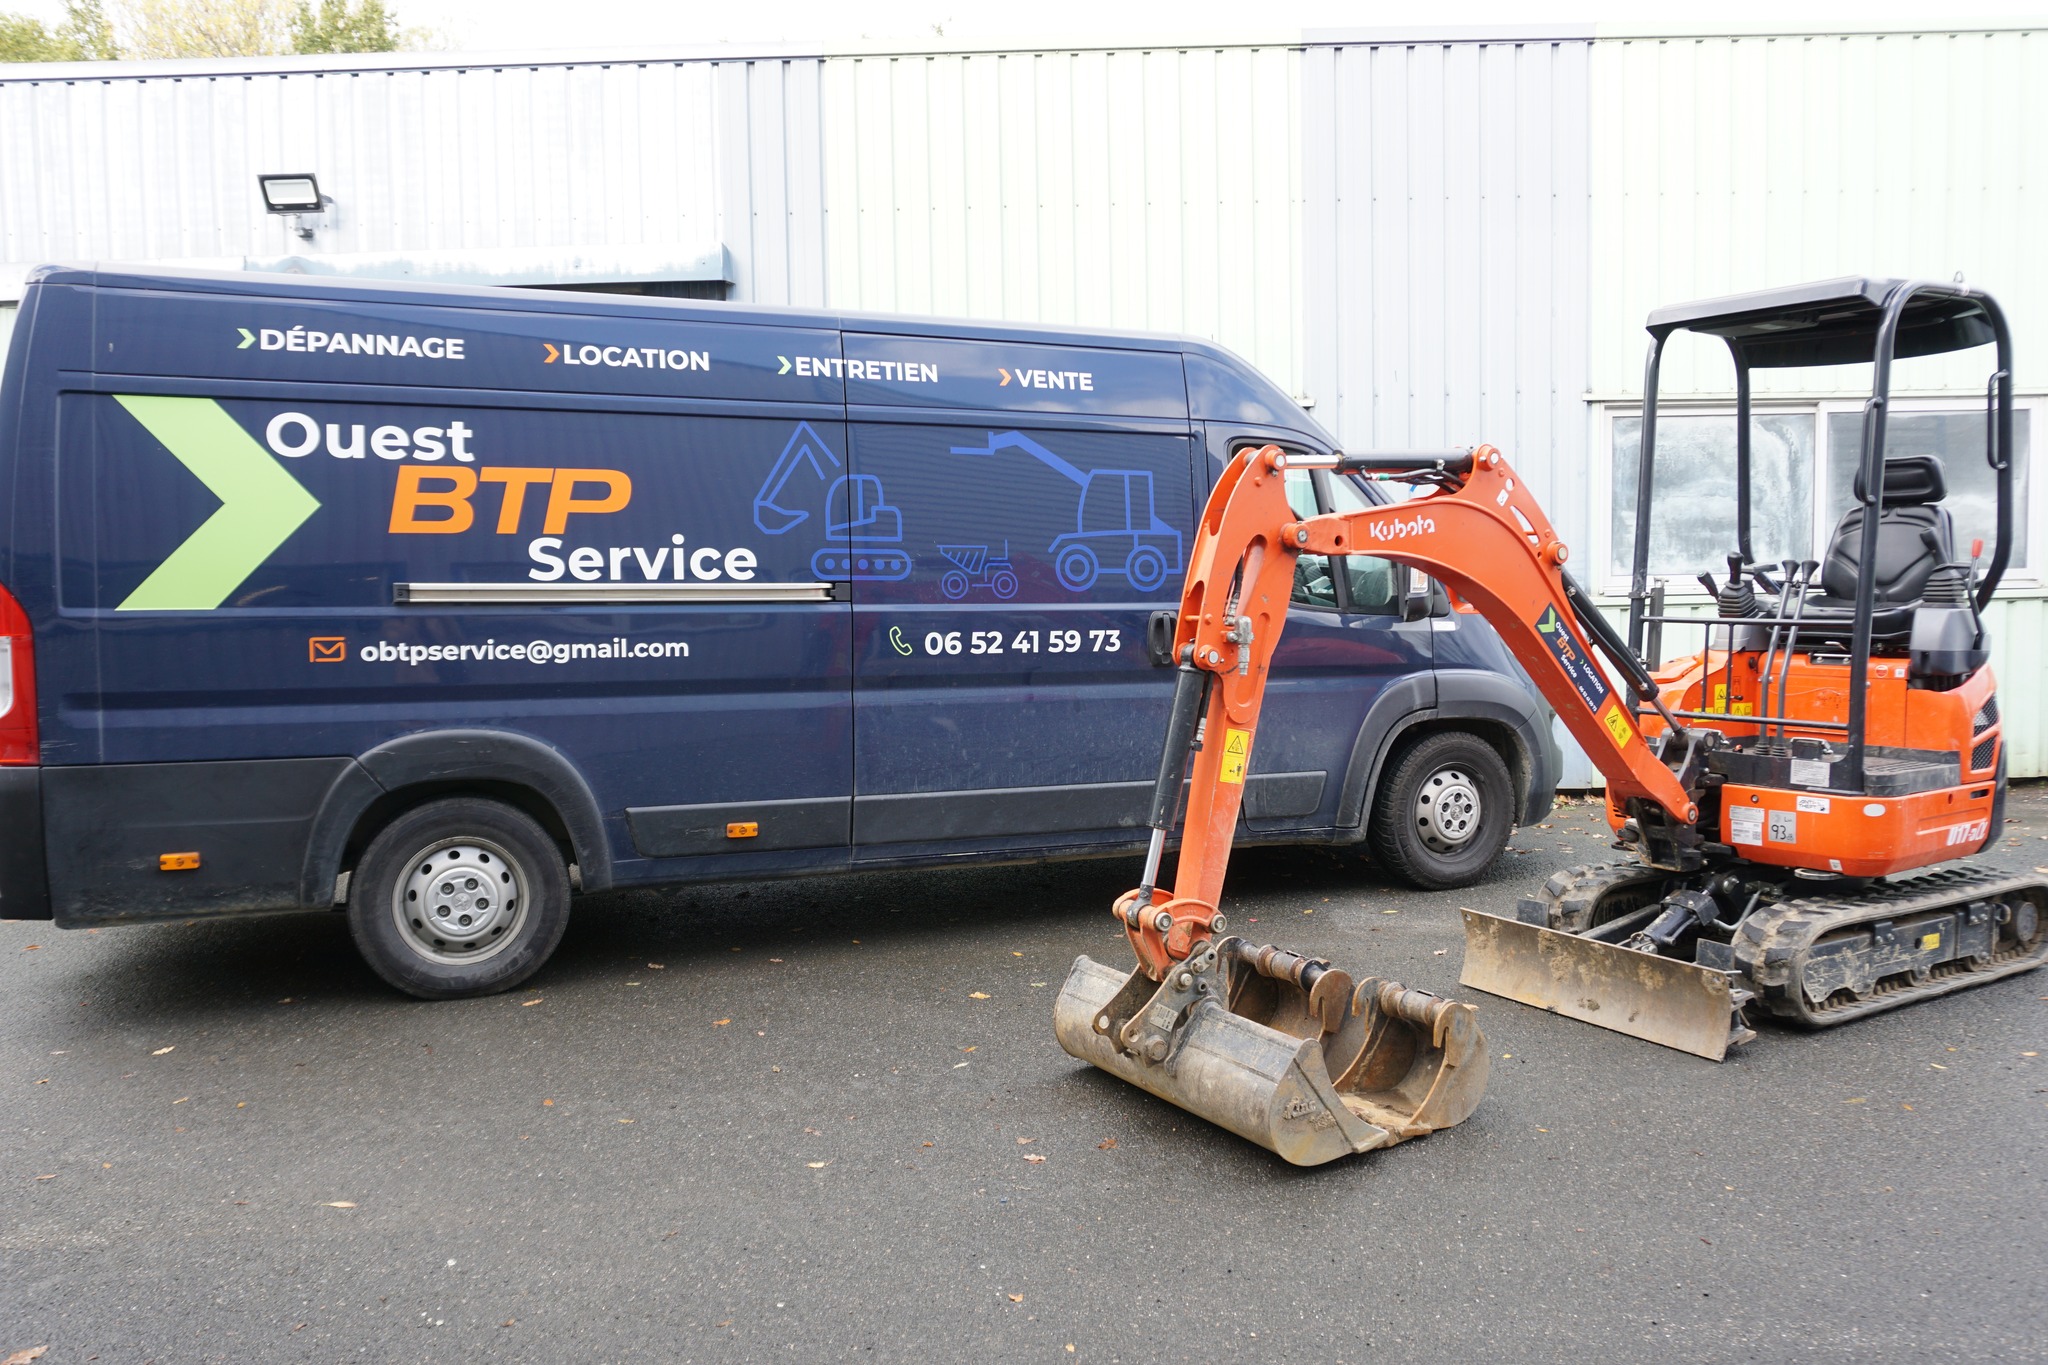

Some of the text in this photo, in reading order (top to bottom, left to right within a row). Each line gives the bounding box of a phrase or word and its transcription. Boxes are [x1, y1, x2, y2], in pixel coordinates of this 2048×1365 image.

[259, 324, 466, 360] DÉPANNAGE
[563, 343, 711, 372] LOCATION
[795, 356, 939, 384] ENTRETIEN
[1015, 367, 1094, 392] VENTE
[265, 411, 476, 463] Ouest
[388, 464, 633, 535] BTP
[1369, 514, 1436, 542] Kubota
[527, 533, 758, 582] Service
[924, 629, 1122, 656] 06 52 41 59 73
[1556, 621, 1570, 642] Ouest
[360, 637, 689, 667] obtpservice@gmail.com
[1556, 636, 1576, 660] BTP
[1560, 654, 1578, 678] Service
[1582, 663, 1605, 694] LOCATION
[1771, 824, 1786, 840] 93
